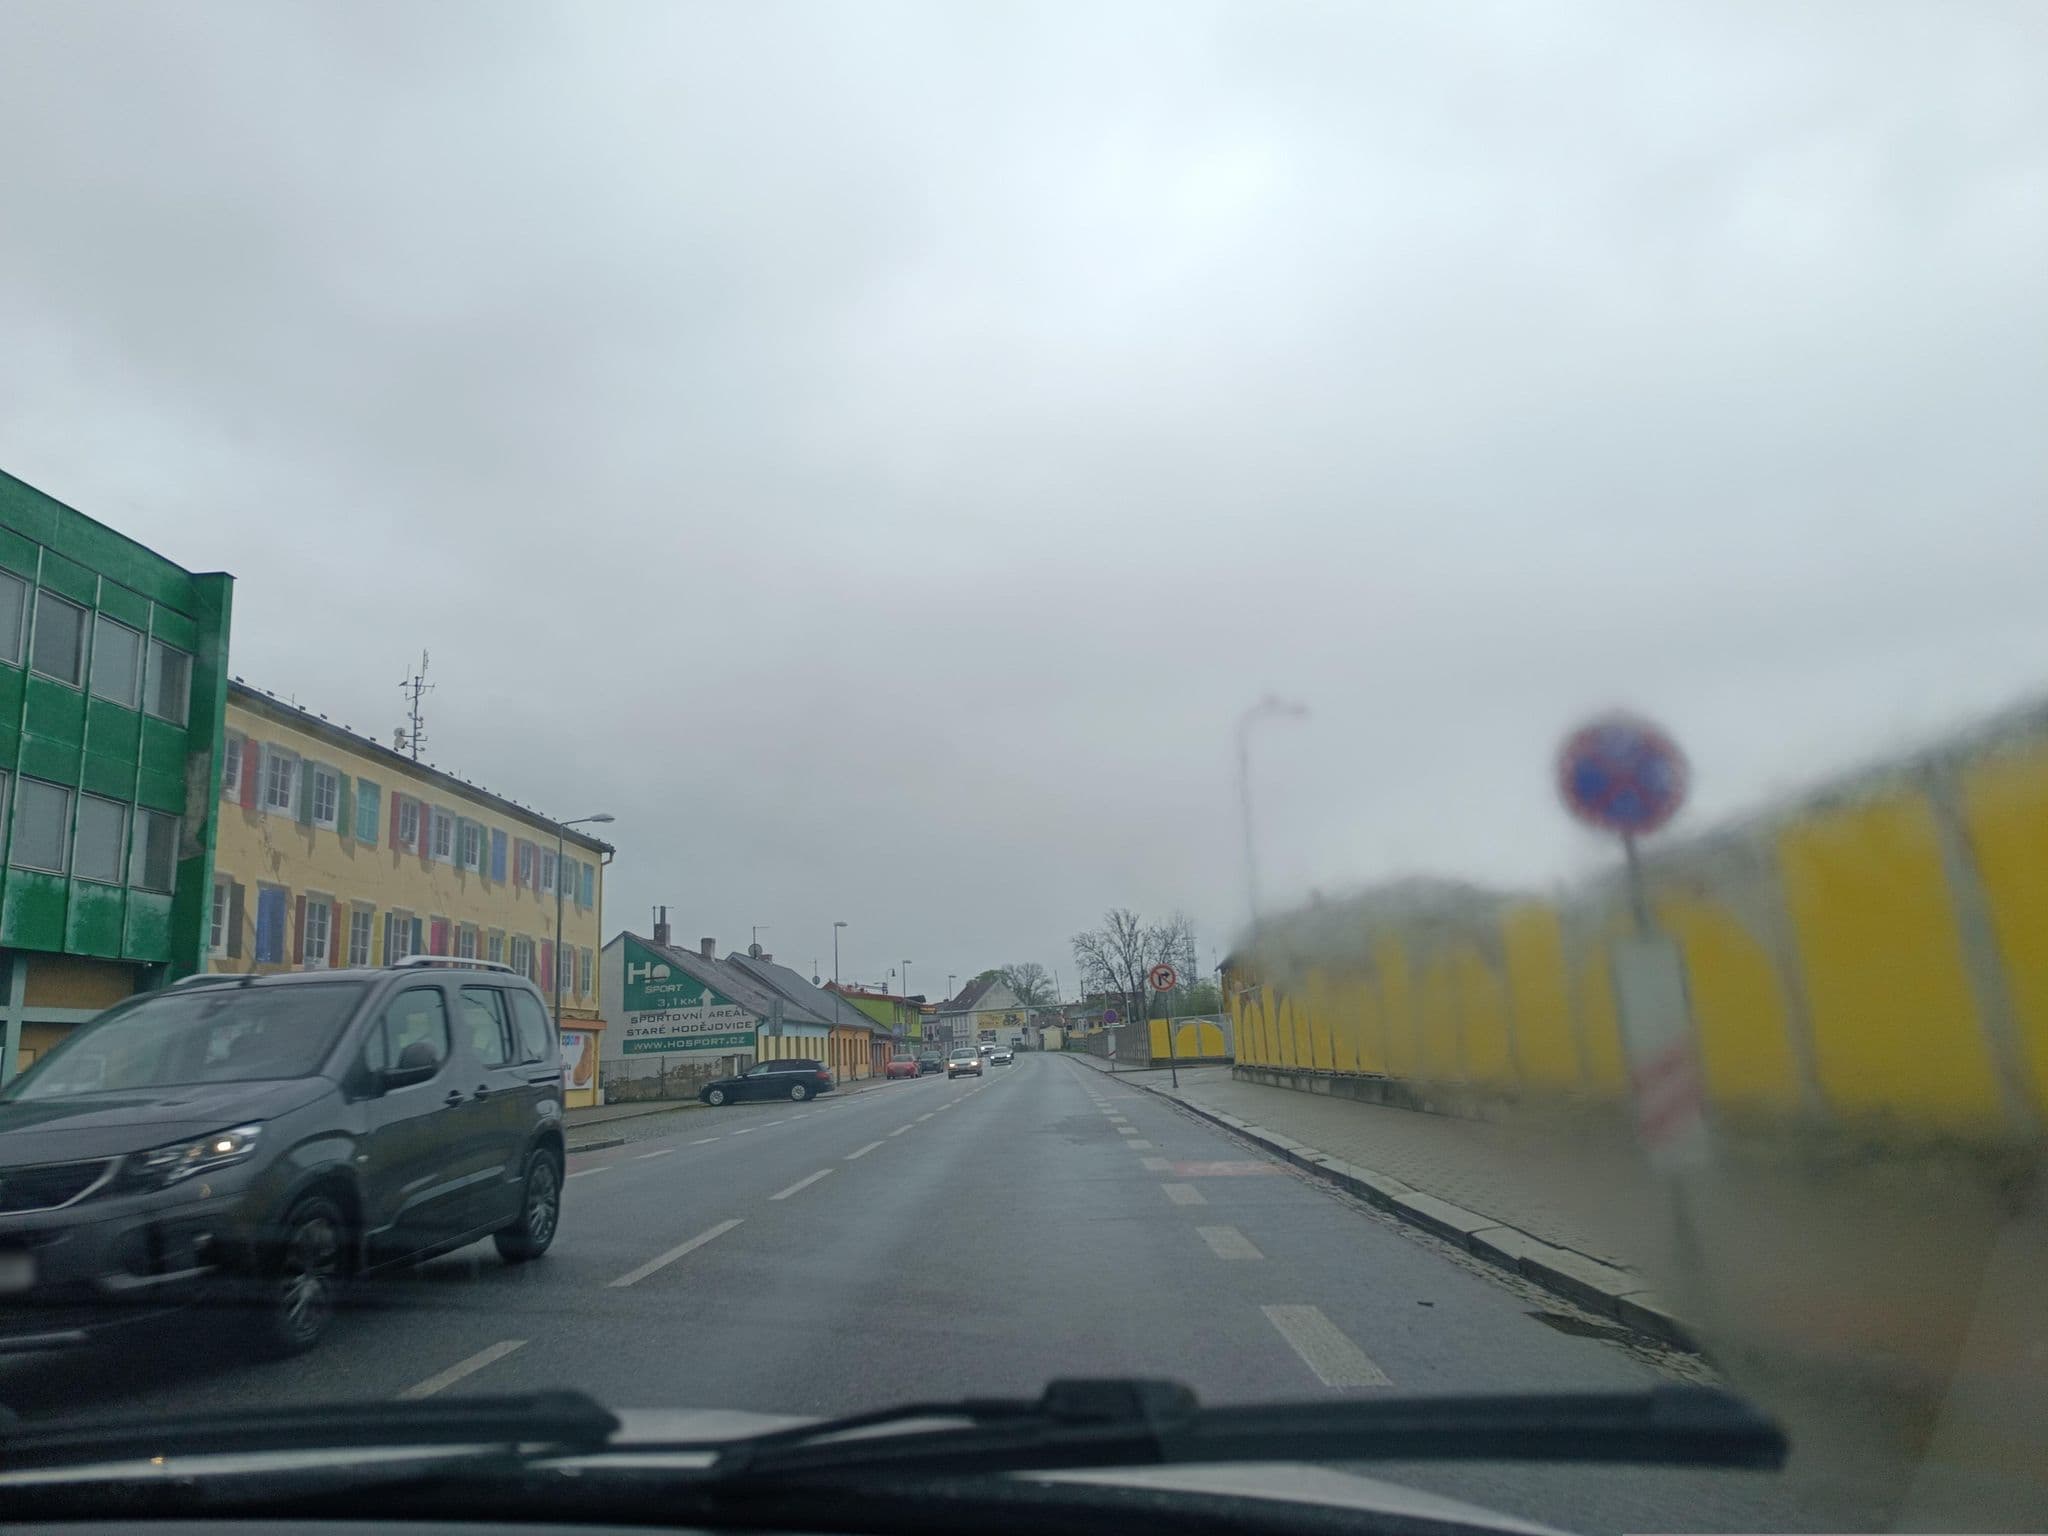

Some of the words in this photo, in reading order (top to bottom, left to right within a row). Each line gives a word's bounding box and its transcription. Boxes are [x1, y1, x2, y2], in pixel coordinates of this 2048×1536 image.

[645, 984, 683, 994] SPORT
[631, 1009, 703, 1024] SPORTOVNÍ
[708, 1007, 748, 1018] AREÁL
[627, 1025, 666, 1037] STARÉ
[672, 1021, 752, 1034] HODĚJOVICE
[634, 1036, 745, 1050] WWW.HOSPORT.CZ
